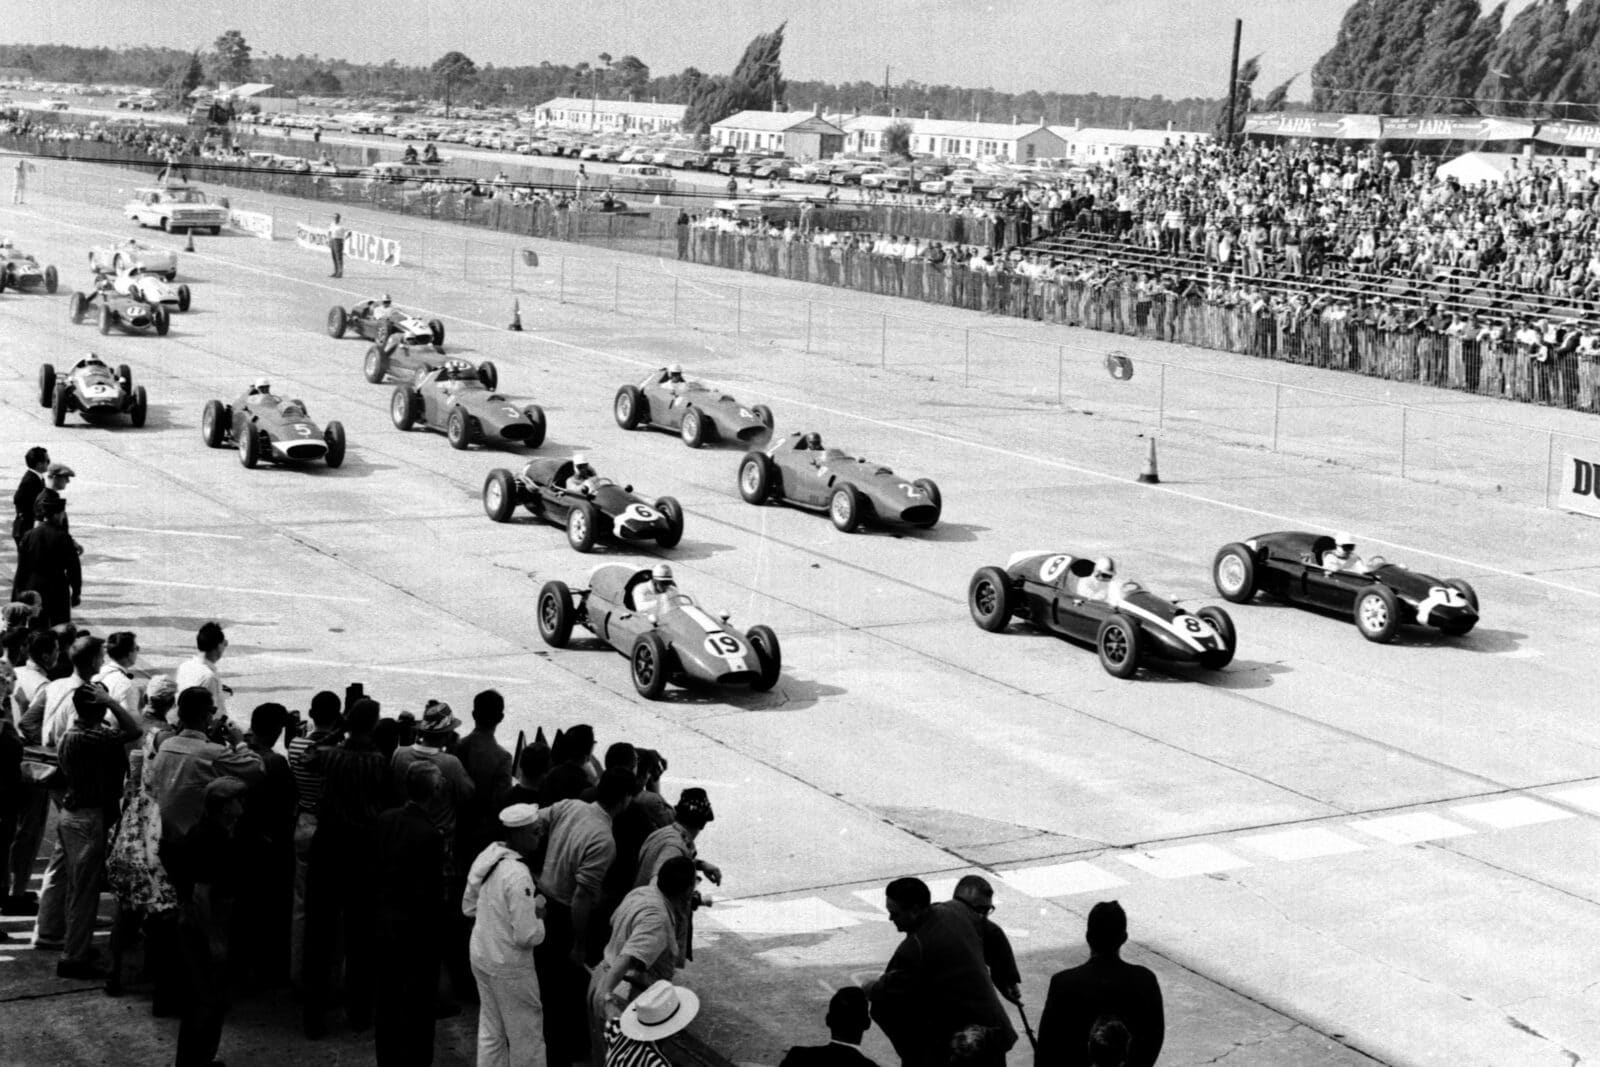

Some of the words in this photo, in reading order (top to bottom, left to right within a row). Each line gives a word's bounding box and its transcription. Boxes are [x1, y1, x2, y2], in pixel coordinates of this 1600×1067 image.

[1277, 117, 1315, 132] LARK
[1416, 118, 1455, 133] LARK
[94, 385, 107, 394] 9
[501, 407, 520, 418] 3
[740, 408, 754, 418] 4
[294, 423, 312, 436] 5
[898, 483, 921, 498] 2
[635, 505, 652, 518] 6
[1047, 556, 1066, 575] 8
[1435, 588, 1451, 603] 7
[1184, 617, 1201, 632] 8
[708, 636, 739, 655] 19
